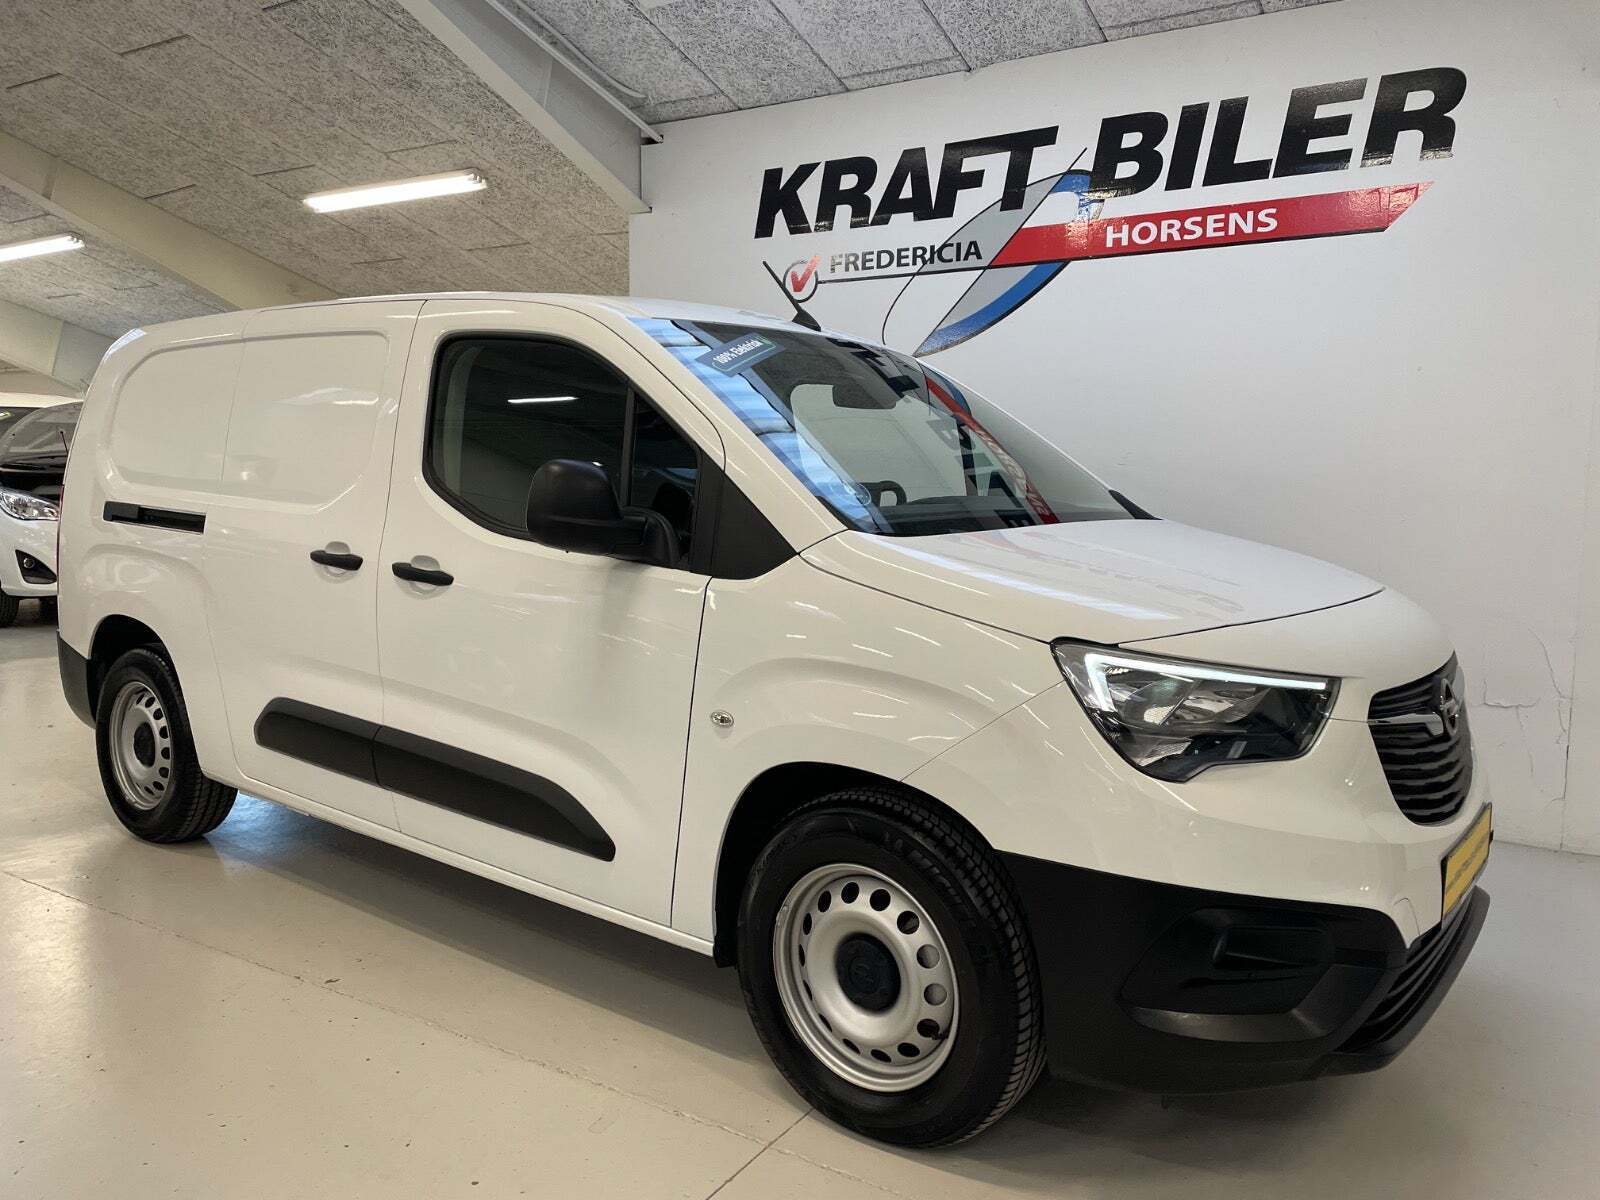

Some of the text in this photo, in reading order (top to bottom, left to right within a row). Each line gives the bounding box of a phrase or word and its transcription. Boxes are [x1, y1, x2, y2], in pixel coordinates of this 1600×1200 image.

[754, 67, 1467, 239] KRAFT BILER
[1105, 207, 1279, 248] HORSENS
[829, 240, 983, 273] FREDERICIA
